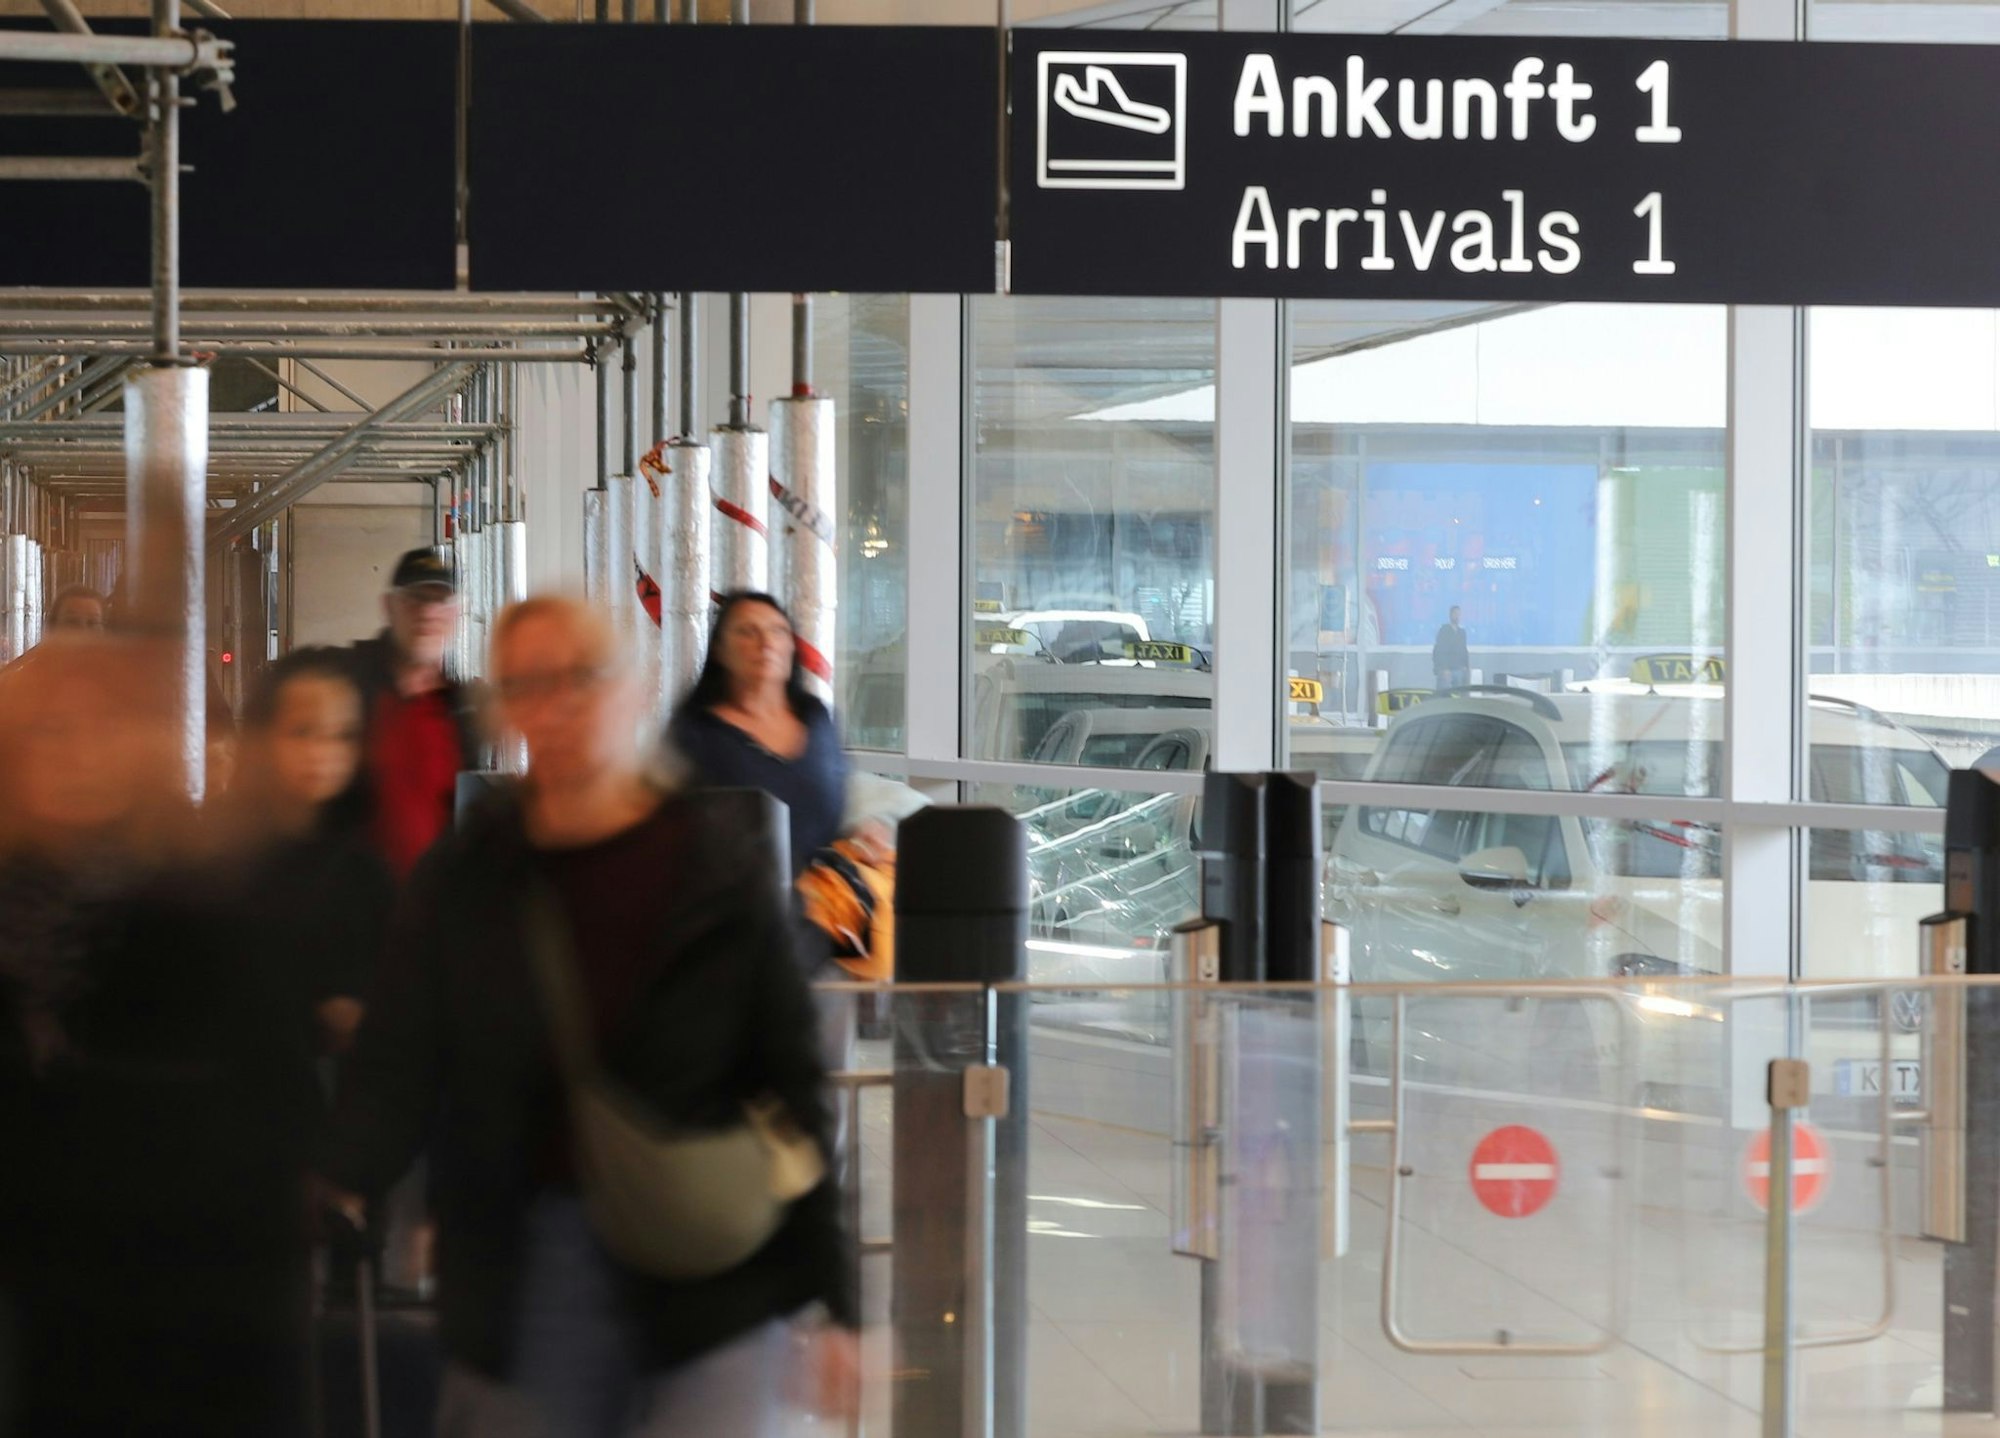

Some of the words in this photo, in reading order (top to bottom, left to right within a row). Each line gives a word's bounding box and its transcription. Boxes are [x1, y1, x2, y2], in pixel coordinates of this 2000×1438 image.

[1233, 53, 1597, 143] Ankunft
[1635, 59, 1682, 143] 1
[1231, 186, 1581, 275] Arrivals
[1632, 191, 1676, 275] 1
[1138, 644, 1181, 659] TAXI
[1290, 682, 1311, 698] XI
